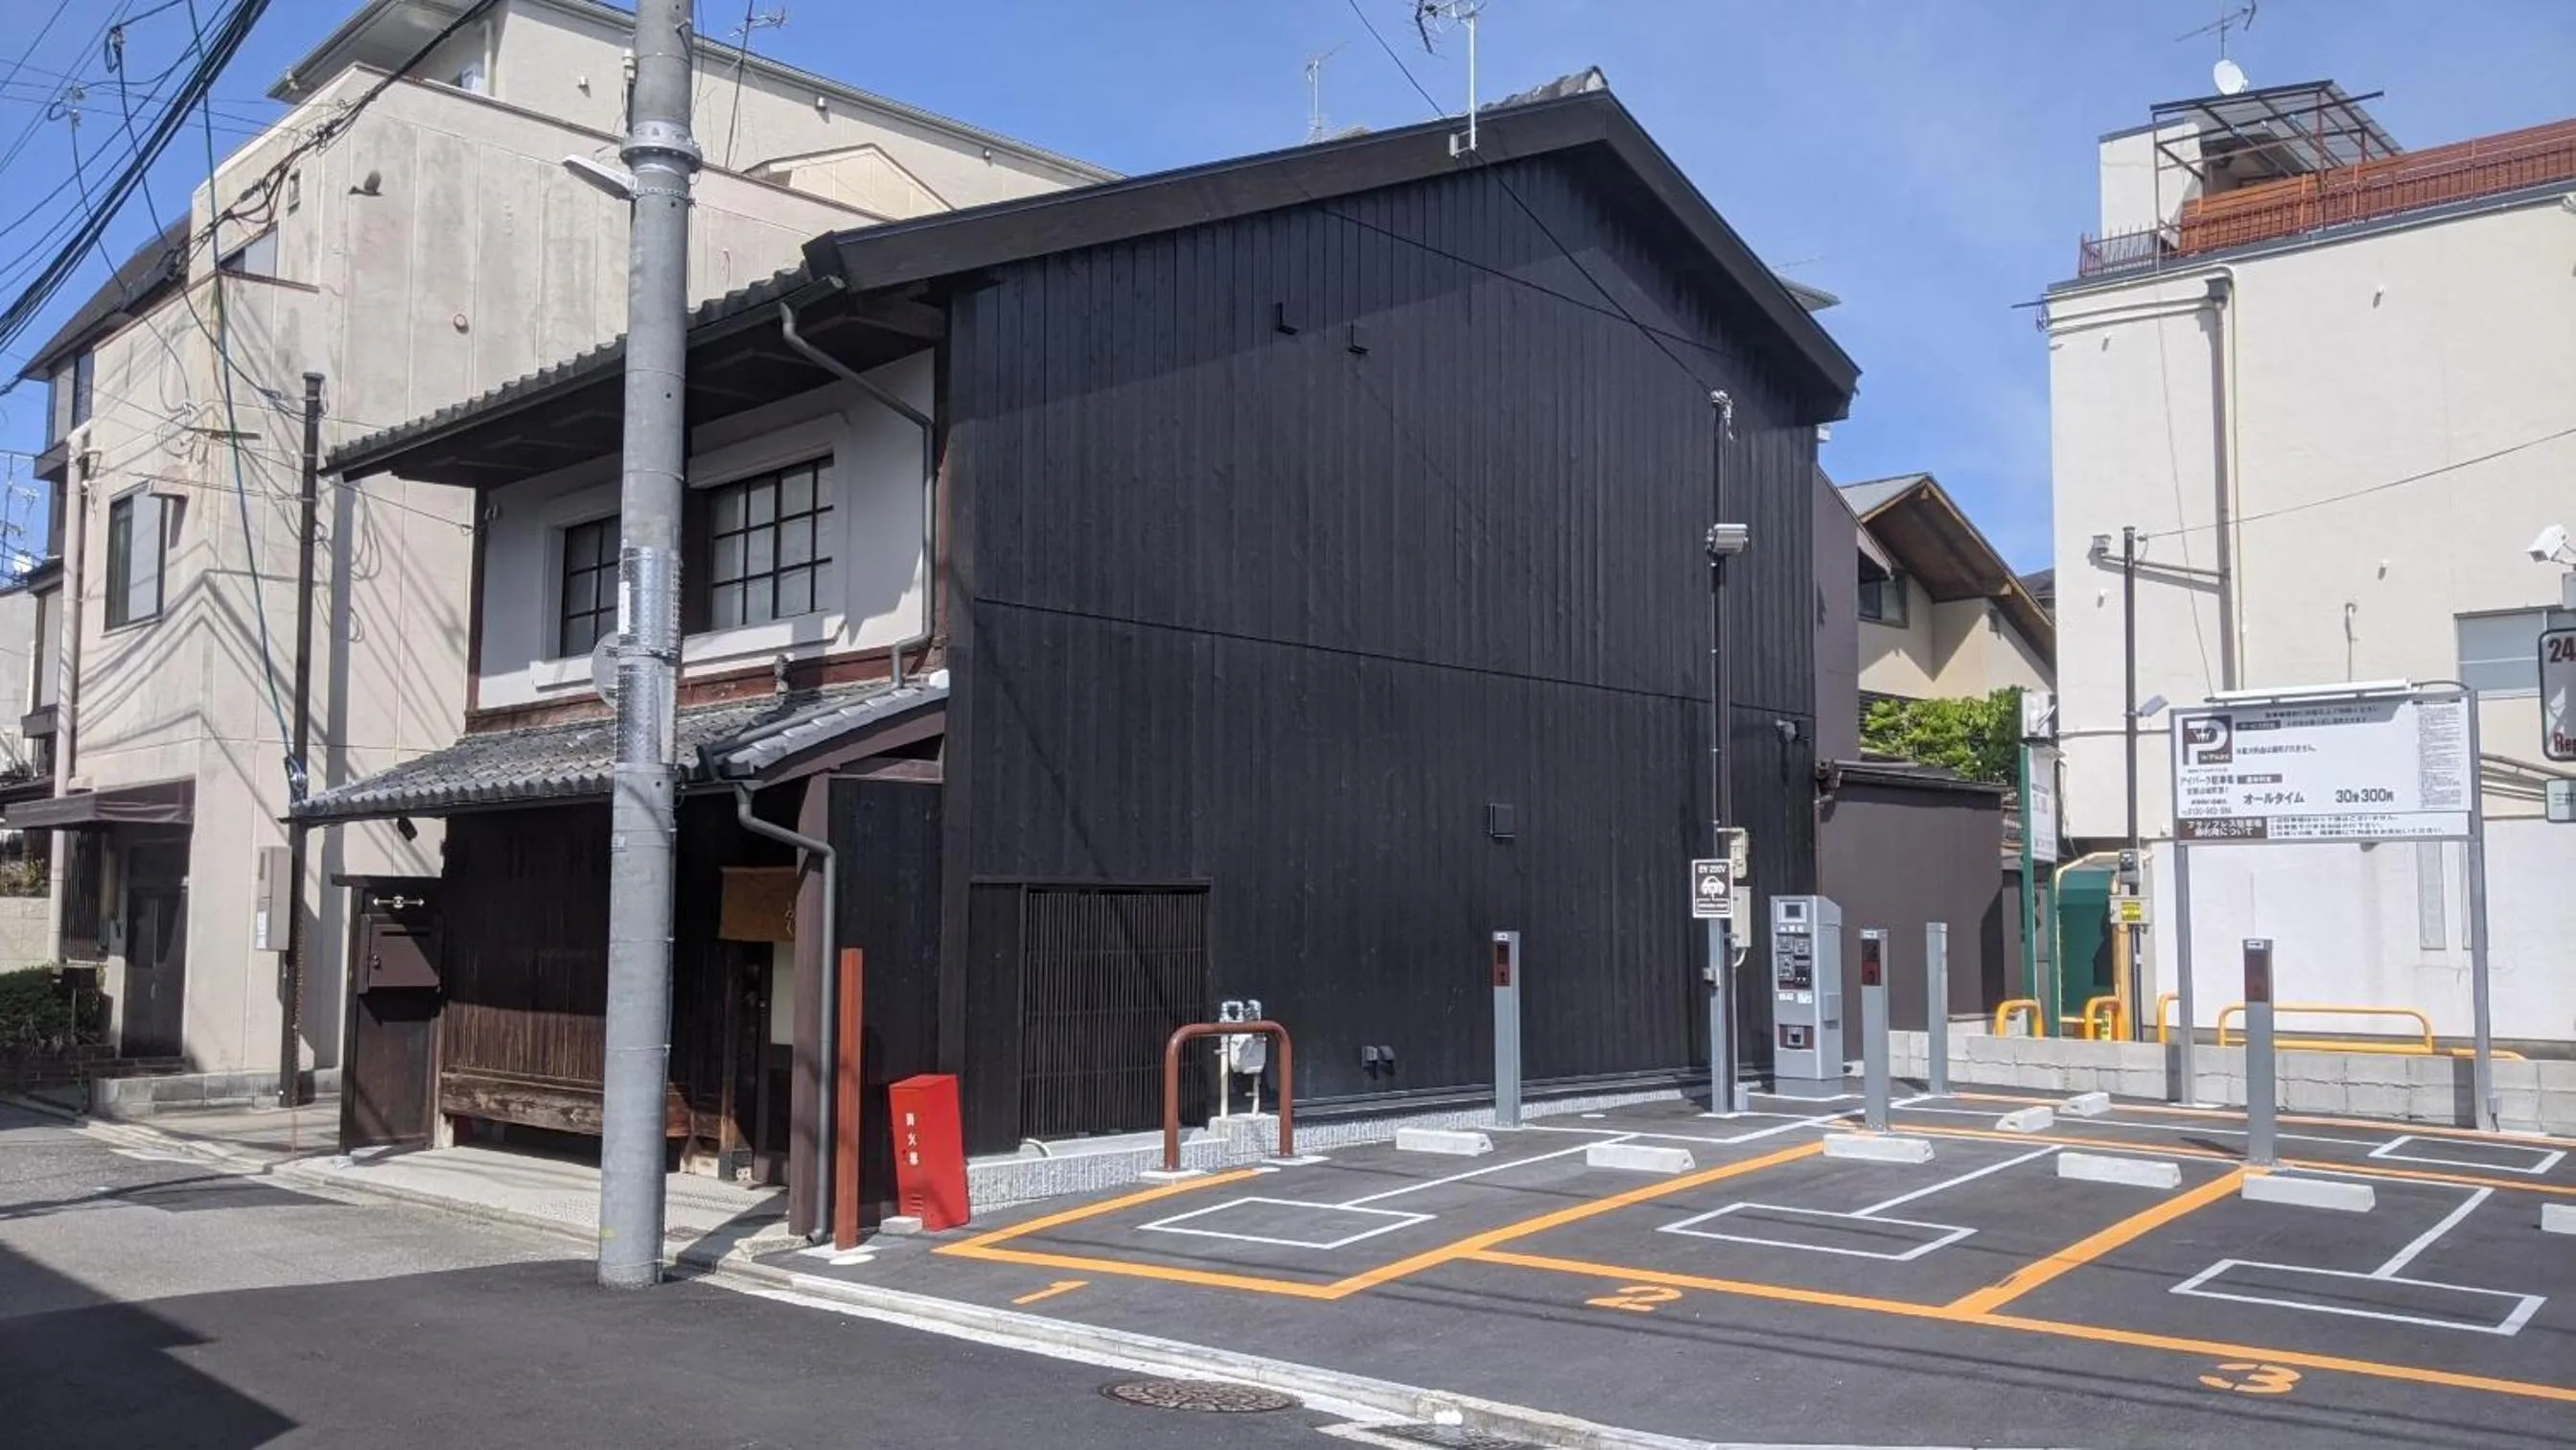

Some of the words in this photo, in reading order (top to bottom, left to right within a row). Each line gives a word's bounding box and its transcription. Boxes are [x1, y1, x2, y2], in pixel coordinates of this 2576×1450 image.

[2243, 790, 2306, 806] オールタイム
[1011, 1280, 1089, 1305] 1
[1584, 1285, 1683, 1313] 2
[2197, 1353, 2303, 1393] 3
